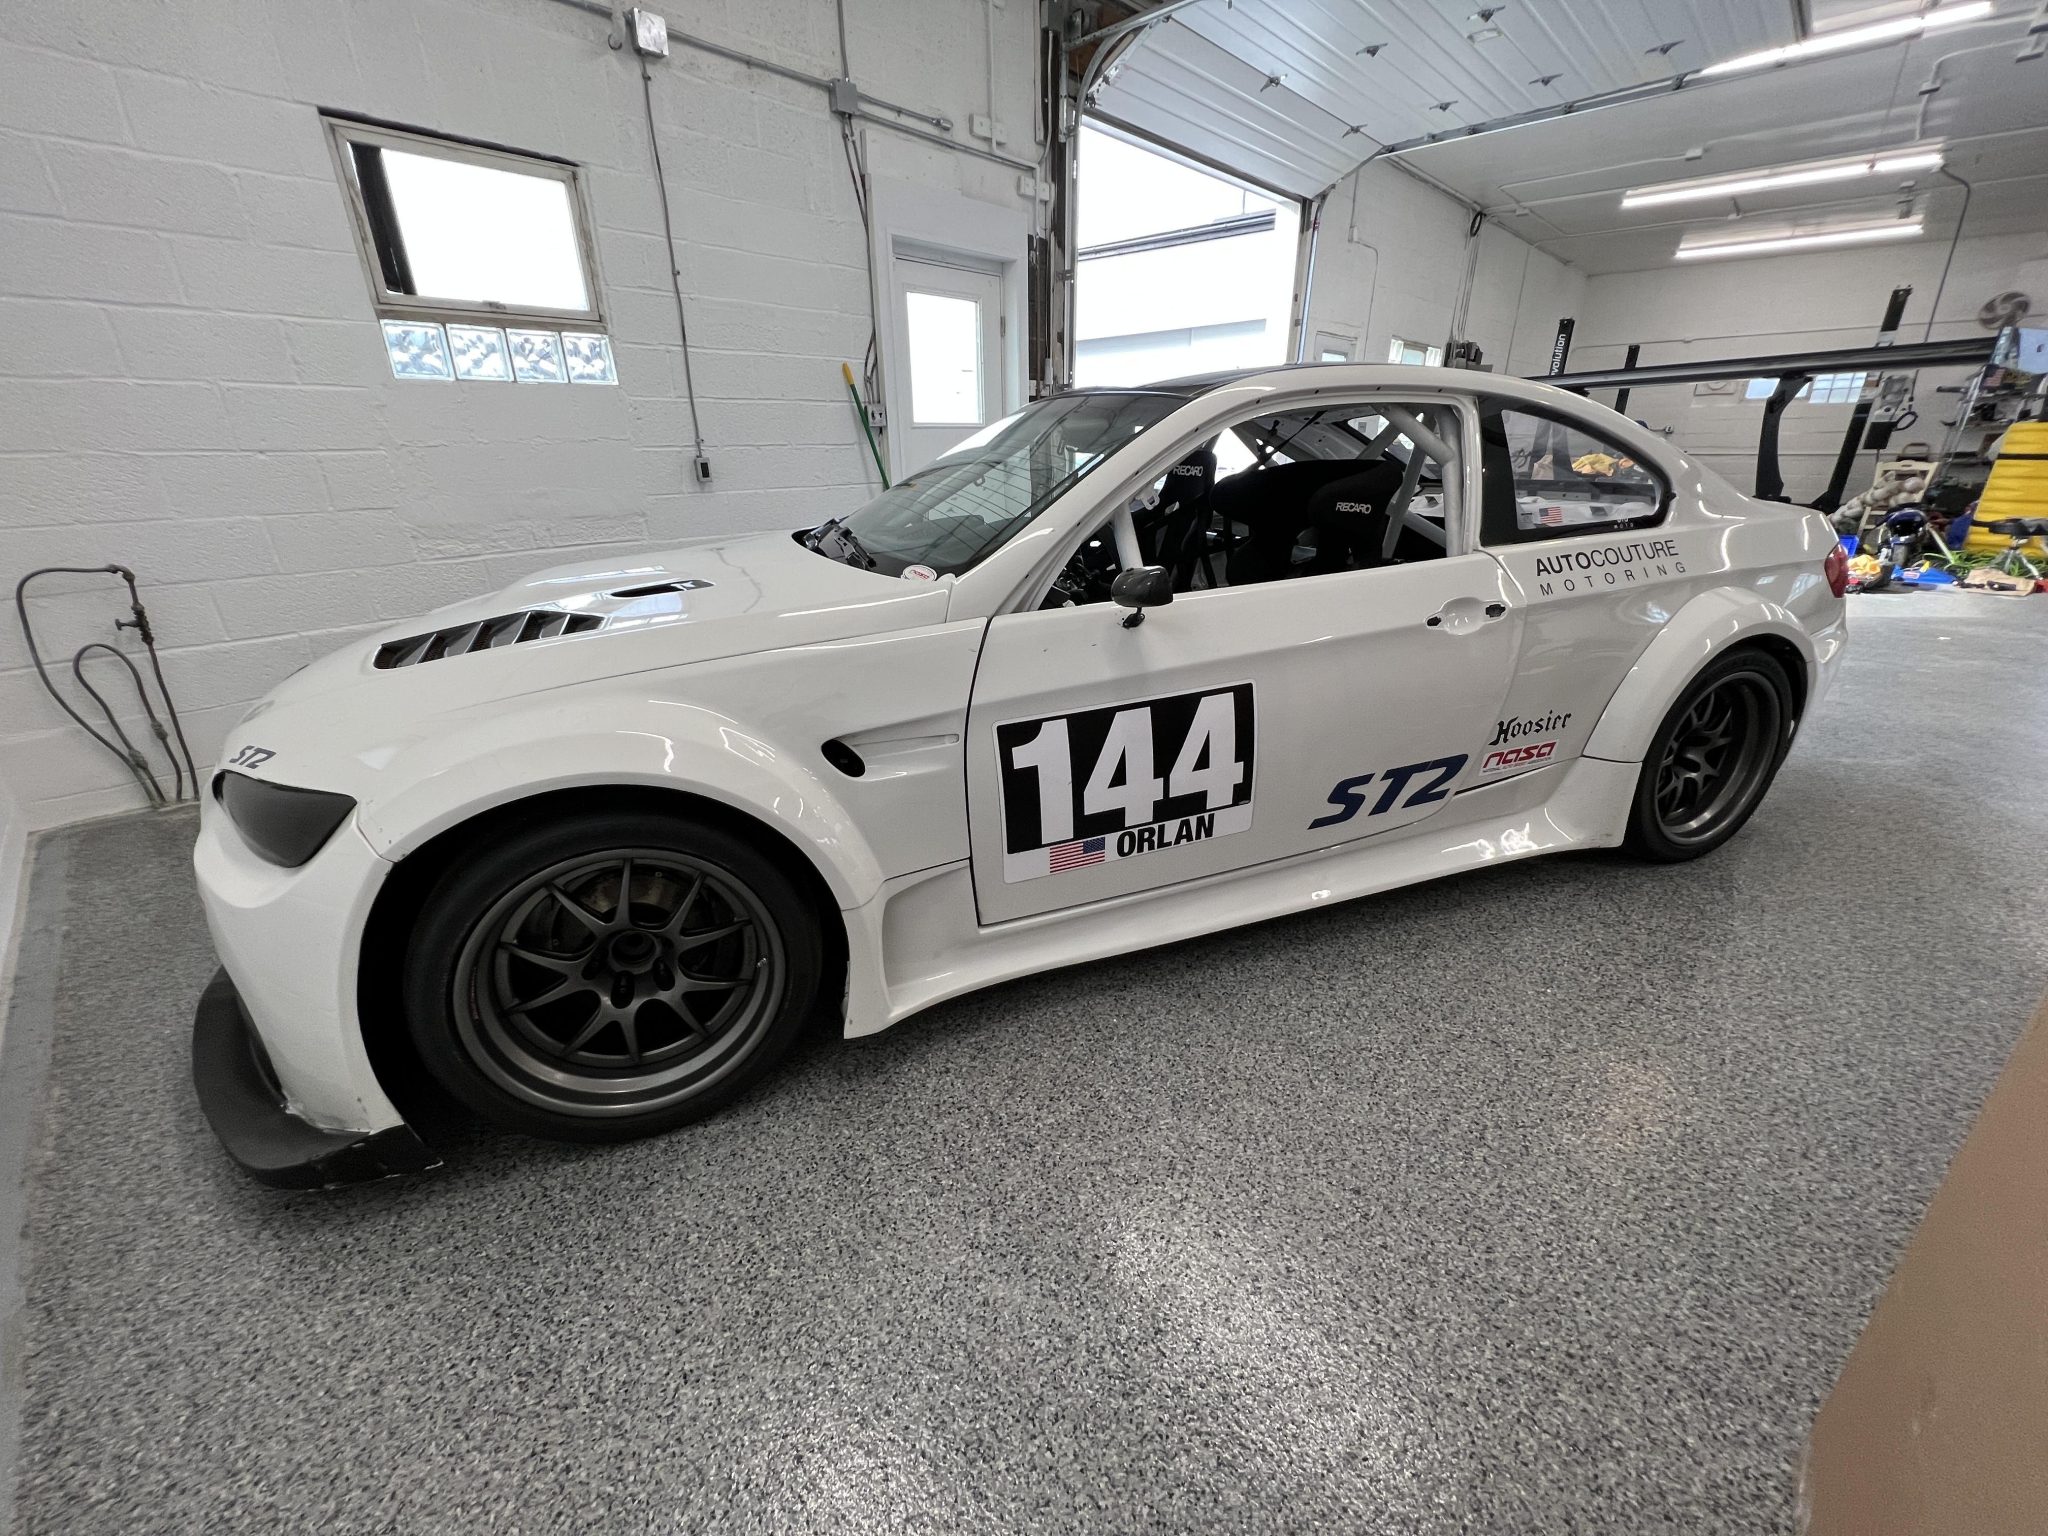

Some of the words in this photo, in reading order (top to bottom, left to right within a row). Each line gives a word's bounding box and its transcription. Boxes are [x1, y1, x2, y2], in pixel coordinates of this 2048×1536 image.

[1173, 465, 1203, 477] RECARO
[1336, 502, 1371, 514] RECARO
[1536, 540, 1679, 576] AUTOCOUTURE
[1539, 561, 1687, 596] MOTORING
[1488, 709, 1572, 745] Hoosier
[229, 745, 277, 770] ST2
[1012, 691, 1244, 845] 144
[1307, 753, 1469, 830] ST2
[1116, 812, 1215, 858] ORLAN
